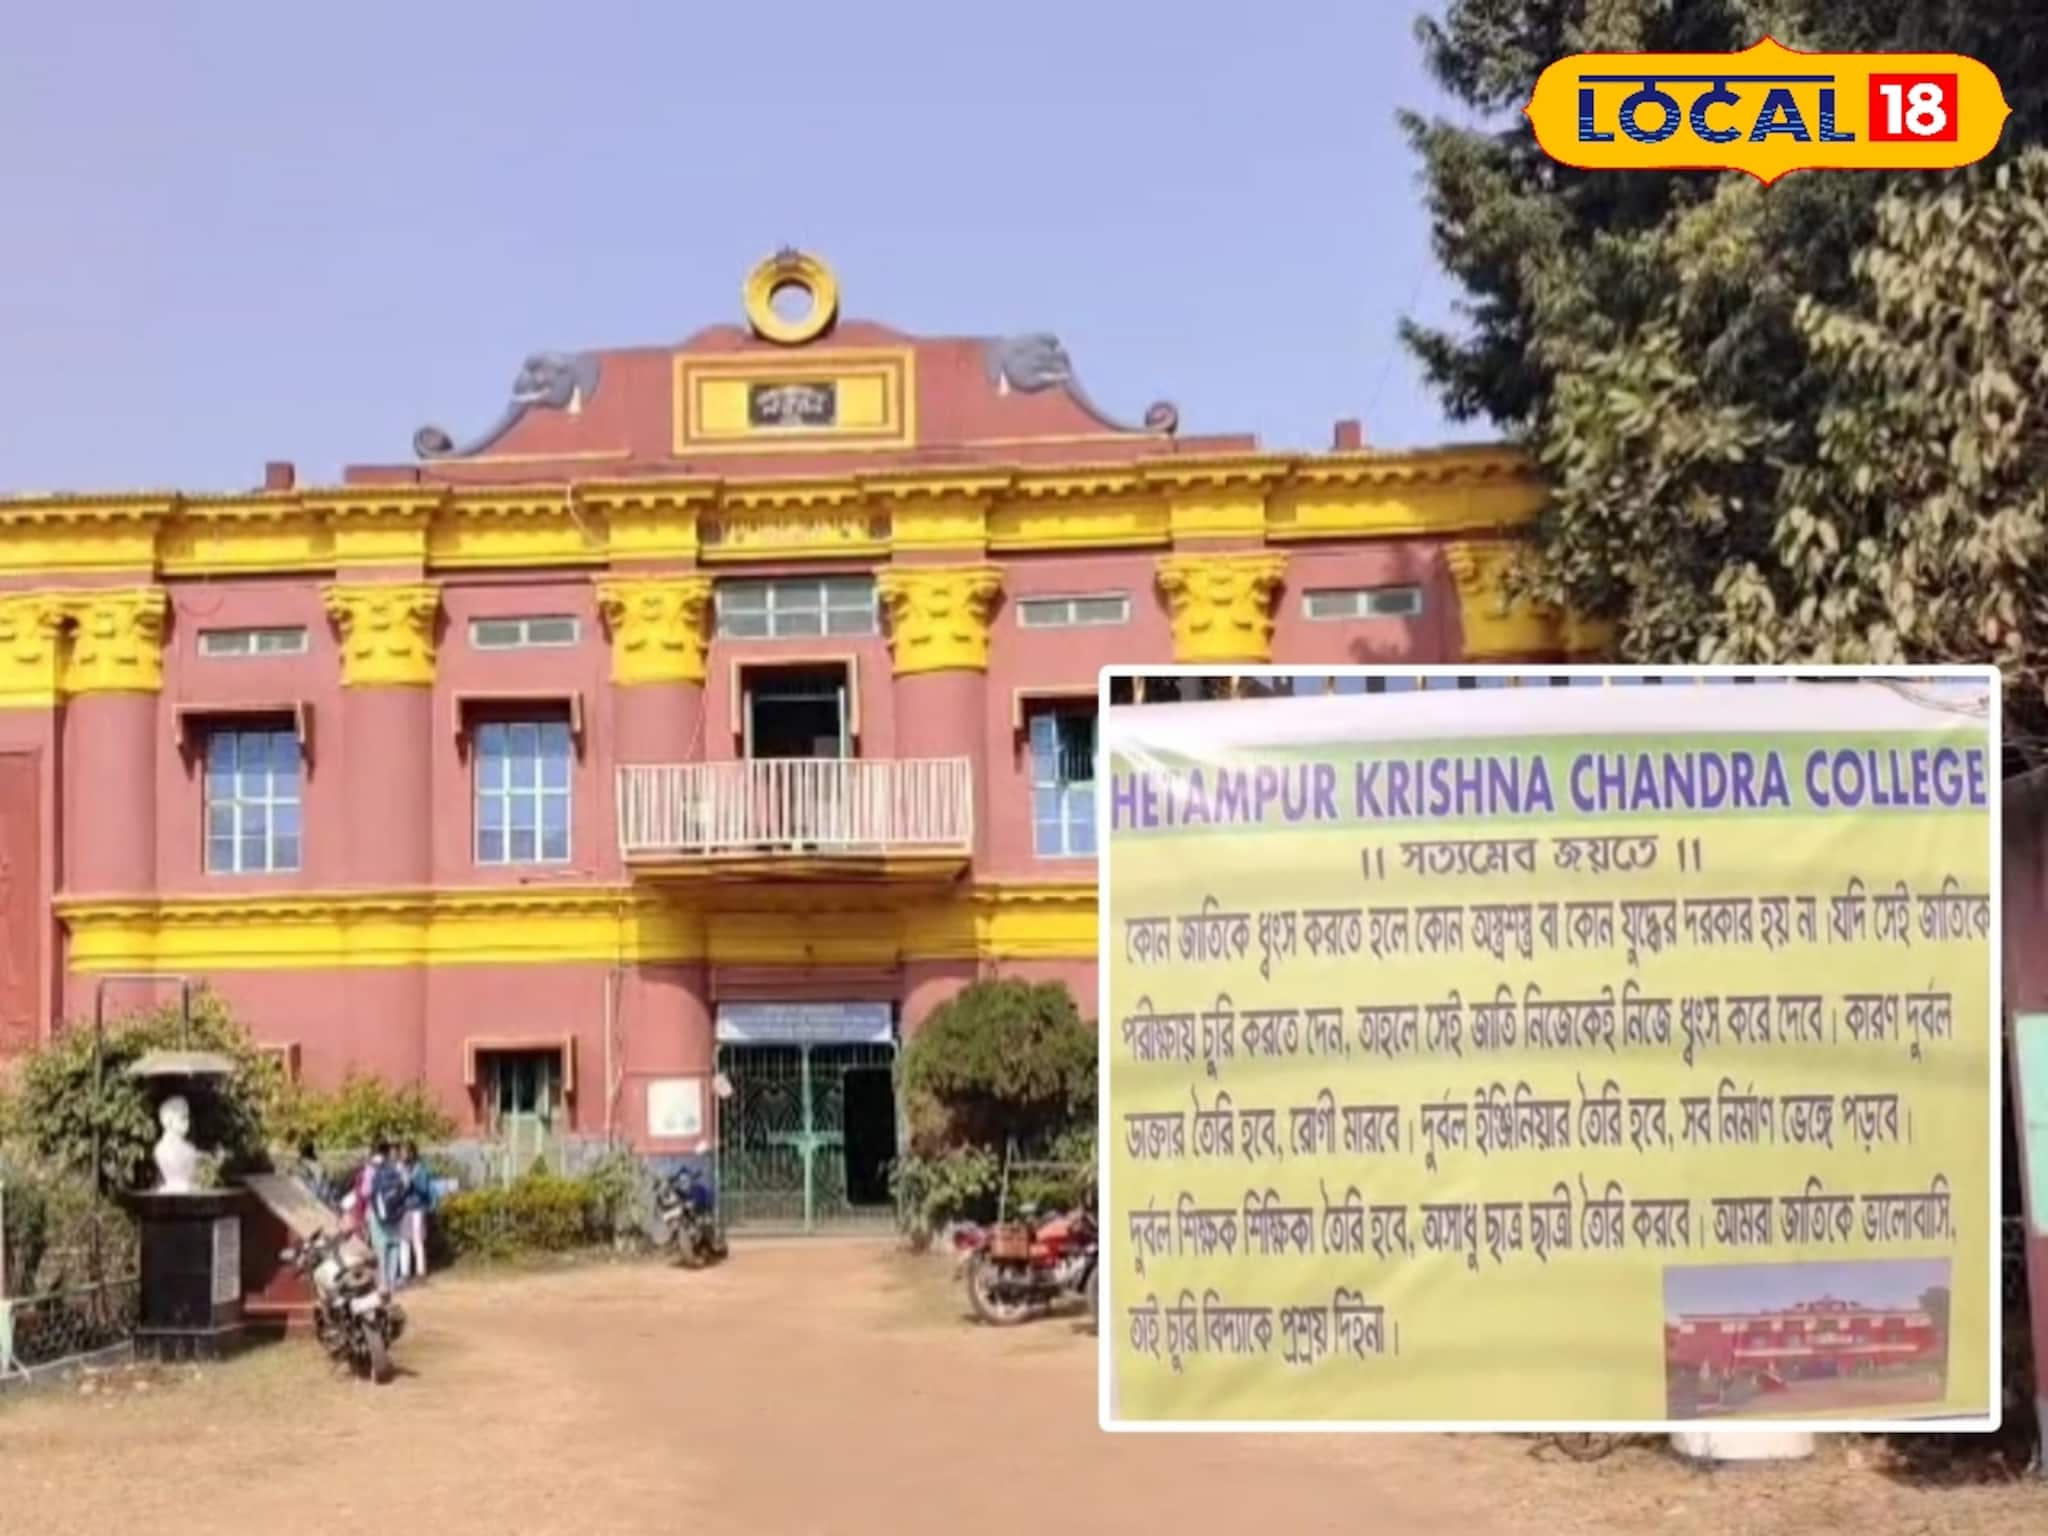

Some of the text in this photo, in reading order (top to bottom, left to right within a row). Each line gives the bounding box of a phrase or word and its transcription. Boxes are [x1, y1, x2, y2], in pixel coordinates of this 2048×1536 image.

[1355, 755, 1555, 817] KRISHNA
[1570, 750, 1790, 811] CHANDRA
[1805, 748, 1986, 807] COLLEGE
[1401, 838, 1538, 875] সত্যমেব
[1553, 836, 1658, 873] জয়তে
[1126, 917, 1170, 963] কোন
[1177, 894, 1250, 960] জাতিকে
[1303, 909, 1362, 956] করতে
[1369, 908, 1408, 959] হলে
[1415, 906, 1464, 952] কোন
[1539, 903, 1558, 949] বা
[1565, 901, 1614, 948] কোন
[1621, 900, 1676, 967] যুদ্ধের
[1684, 898, 1752, 945] দরকার
[1759, 897, 1789, 946] হয়
[1796, 896, 1816, 943] না
[1873, 880, 1910, 948] সেই
[1201, 992, 1234, 1079] চুরি
[1241, 1009, 1299, 1057] করতে
[1357, 1004, 1418, 1059] তাহলে
[1425, 989, 1462, 1057] সেই
[1470, 983, 1516, 1050] জাতি
[1524, 983, 1615, 1054] নিজেকেই
[1623, 979, 1672, 1046] নিজে
[1726, 996, 1770, 1044] করে
[1777, 996, 1822, 1043] দেবে
[1844, 994, 1898, 1041] কারণ
[1906, 978, 1951, 1061] দুর্বল
[1124, 1112, 1184, 1159] ডাক্তার
[1191, 1084, 1234, 1158] তৈরি
[1289, 1088, 1335, 1155] রোগী
[1342, 1106, 1399, 1154] মারবে
[1421, 1088, 1468, 1172] দুর্বল
[1577, 1072, 1622, 1147] তৈরি
[1681, 1098, 1710, 1144] সব
[1718, 1077, 1774, 1145] নির্মাণ
[1780, 1095, 1834, 1149] ভেঙ্গে
[1842, 1094, 1898, 1153] পড়বে
[1128, 1195, 1170, 1278] দুর্বল
[1177, 1191, 1236, 1256] শিক্ষক
[1243, 1189, 1314, 1256] শিক্ষিকা
[1320, 1178, 1363, 1254] তৈরি
[1421, 1204, 1478, 1272] অসাধু
[1485, 1203, 1522, 1264] ছাত্র
[1529, 1181, 1572, 1263] ছাত্রী
[1579, 1172, 1624, 1249] তৈরি
[1631, 1200, 1689, 1248] করবে
[1712, 1198, 1772, 1246] আমরা
[1780, 1175, 1854, 1243] জাতিকে
[1129, 1293, 1160, 1360] তাই
[1166, 1288, 1197, 1374] চুরি
[1204, 1288, 1272, 1353] বিদ্যাকে
